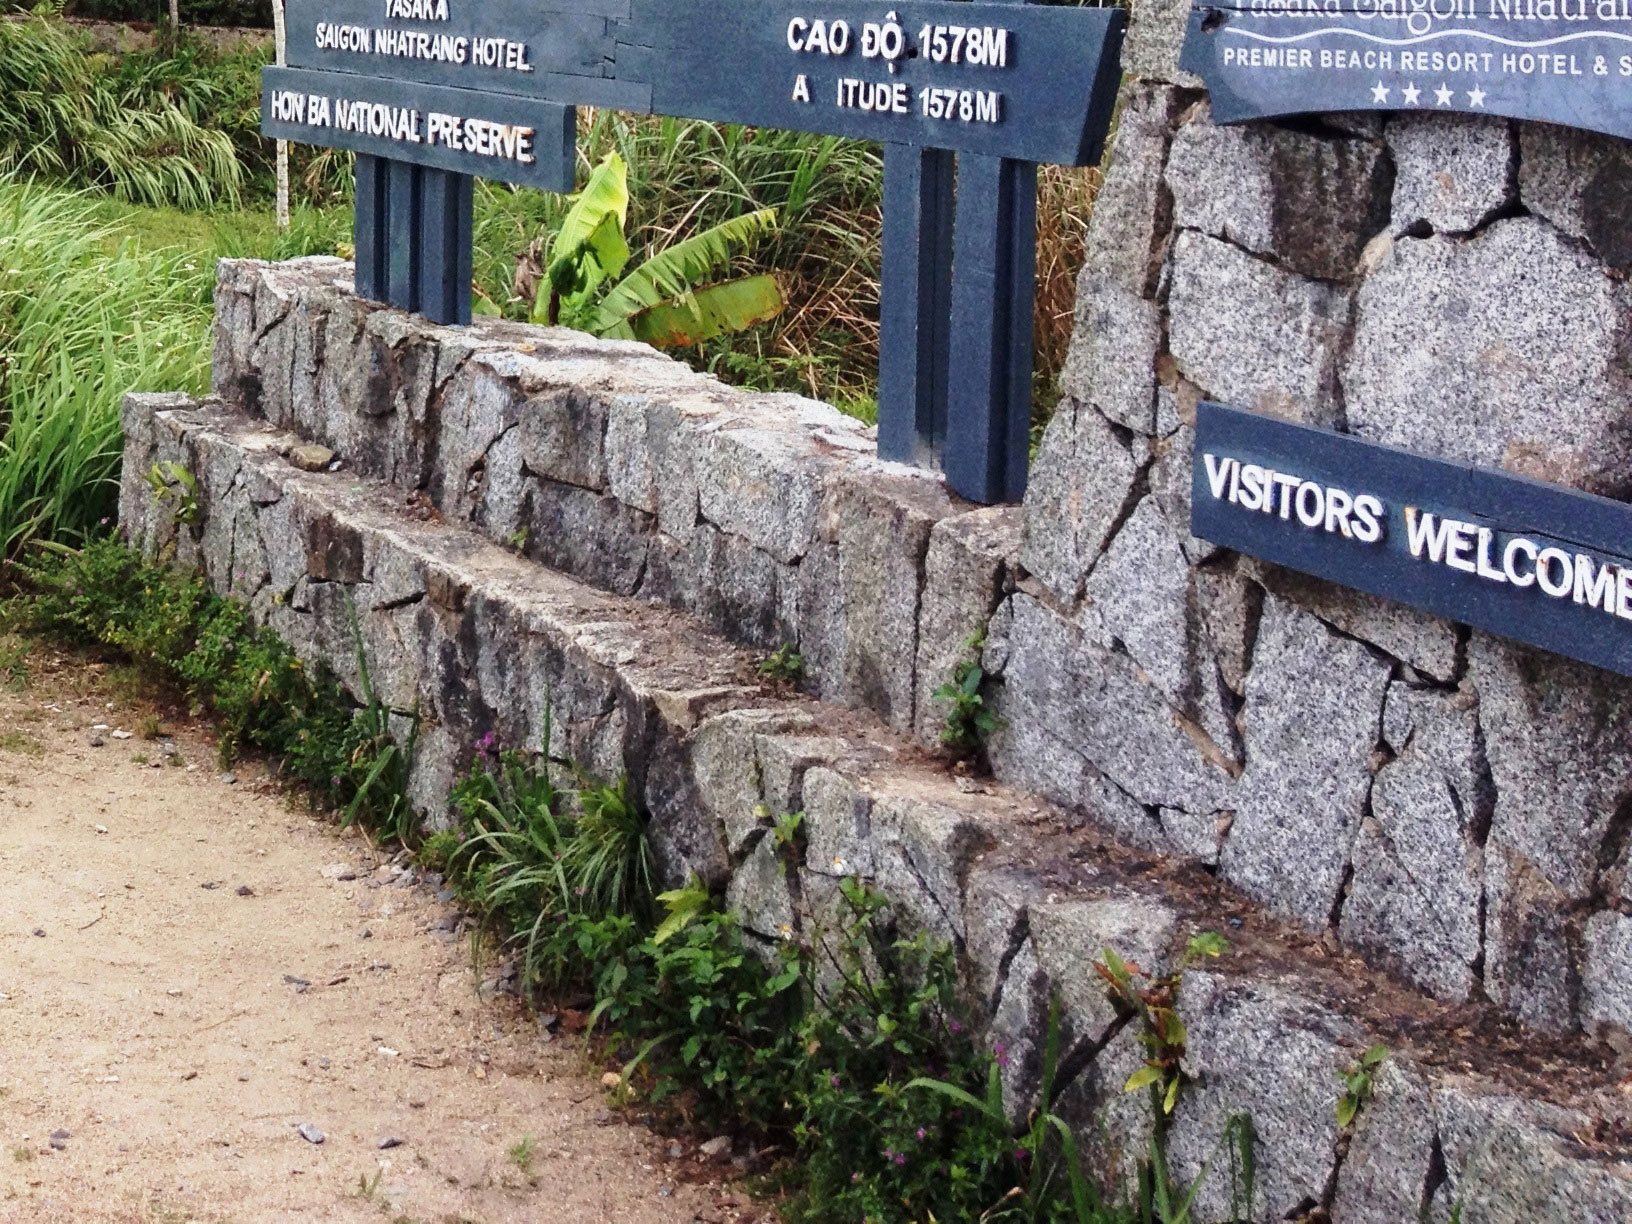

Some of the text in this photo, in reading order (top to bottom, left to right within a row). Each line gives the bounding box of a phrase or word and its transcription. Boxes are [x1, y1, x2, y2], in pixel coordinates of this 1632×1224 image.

[315, 22, 534, 72] SAIGON NHATRANG HOTEL
[787, 10, 1008, 74] CAO ĐỘ 1578M
[1224, 47, 1313, 69] PREMIER
[1320, 48, 1392, 70] BEACH
[1400, 50, 1493, 72] RESORT
[1502, 52, 1582, 76] HOTEL
[1593, 55, 1608, 76] &
[271, 90, 536, 164] HON BA NATIONAL PRESERVE
[918, 87, 1000, 123] 1578M
[1202, 453, 1385, 544] VISITORS
